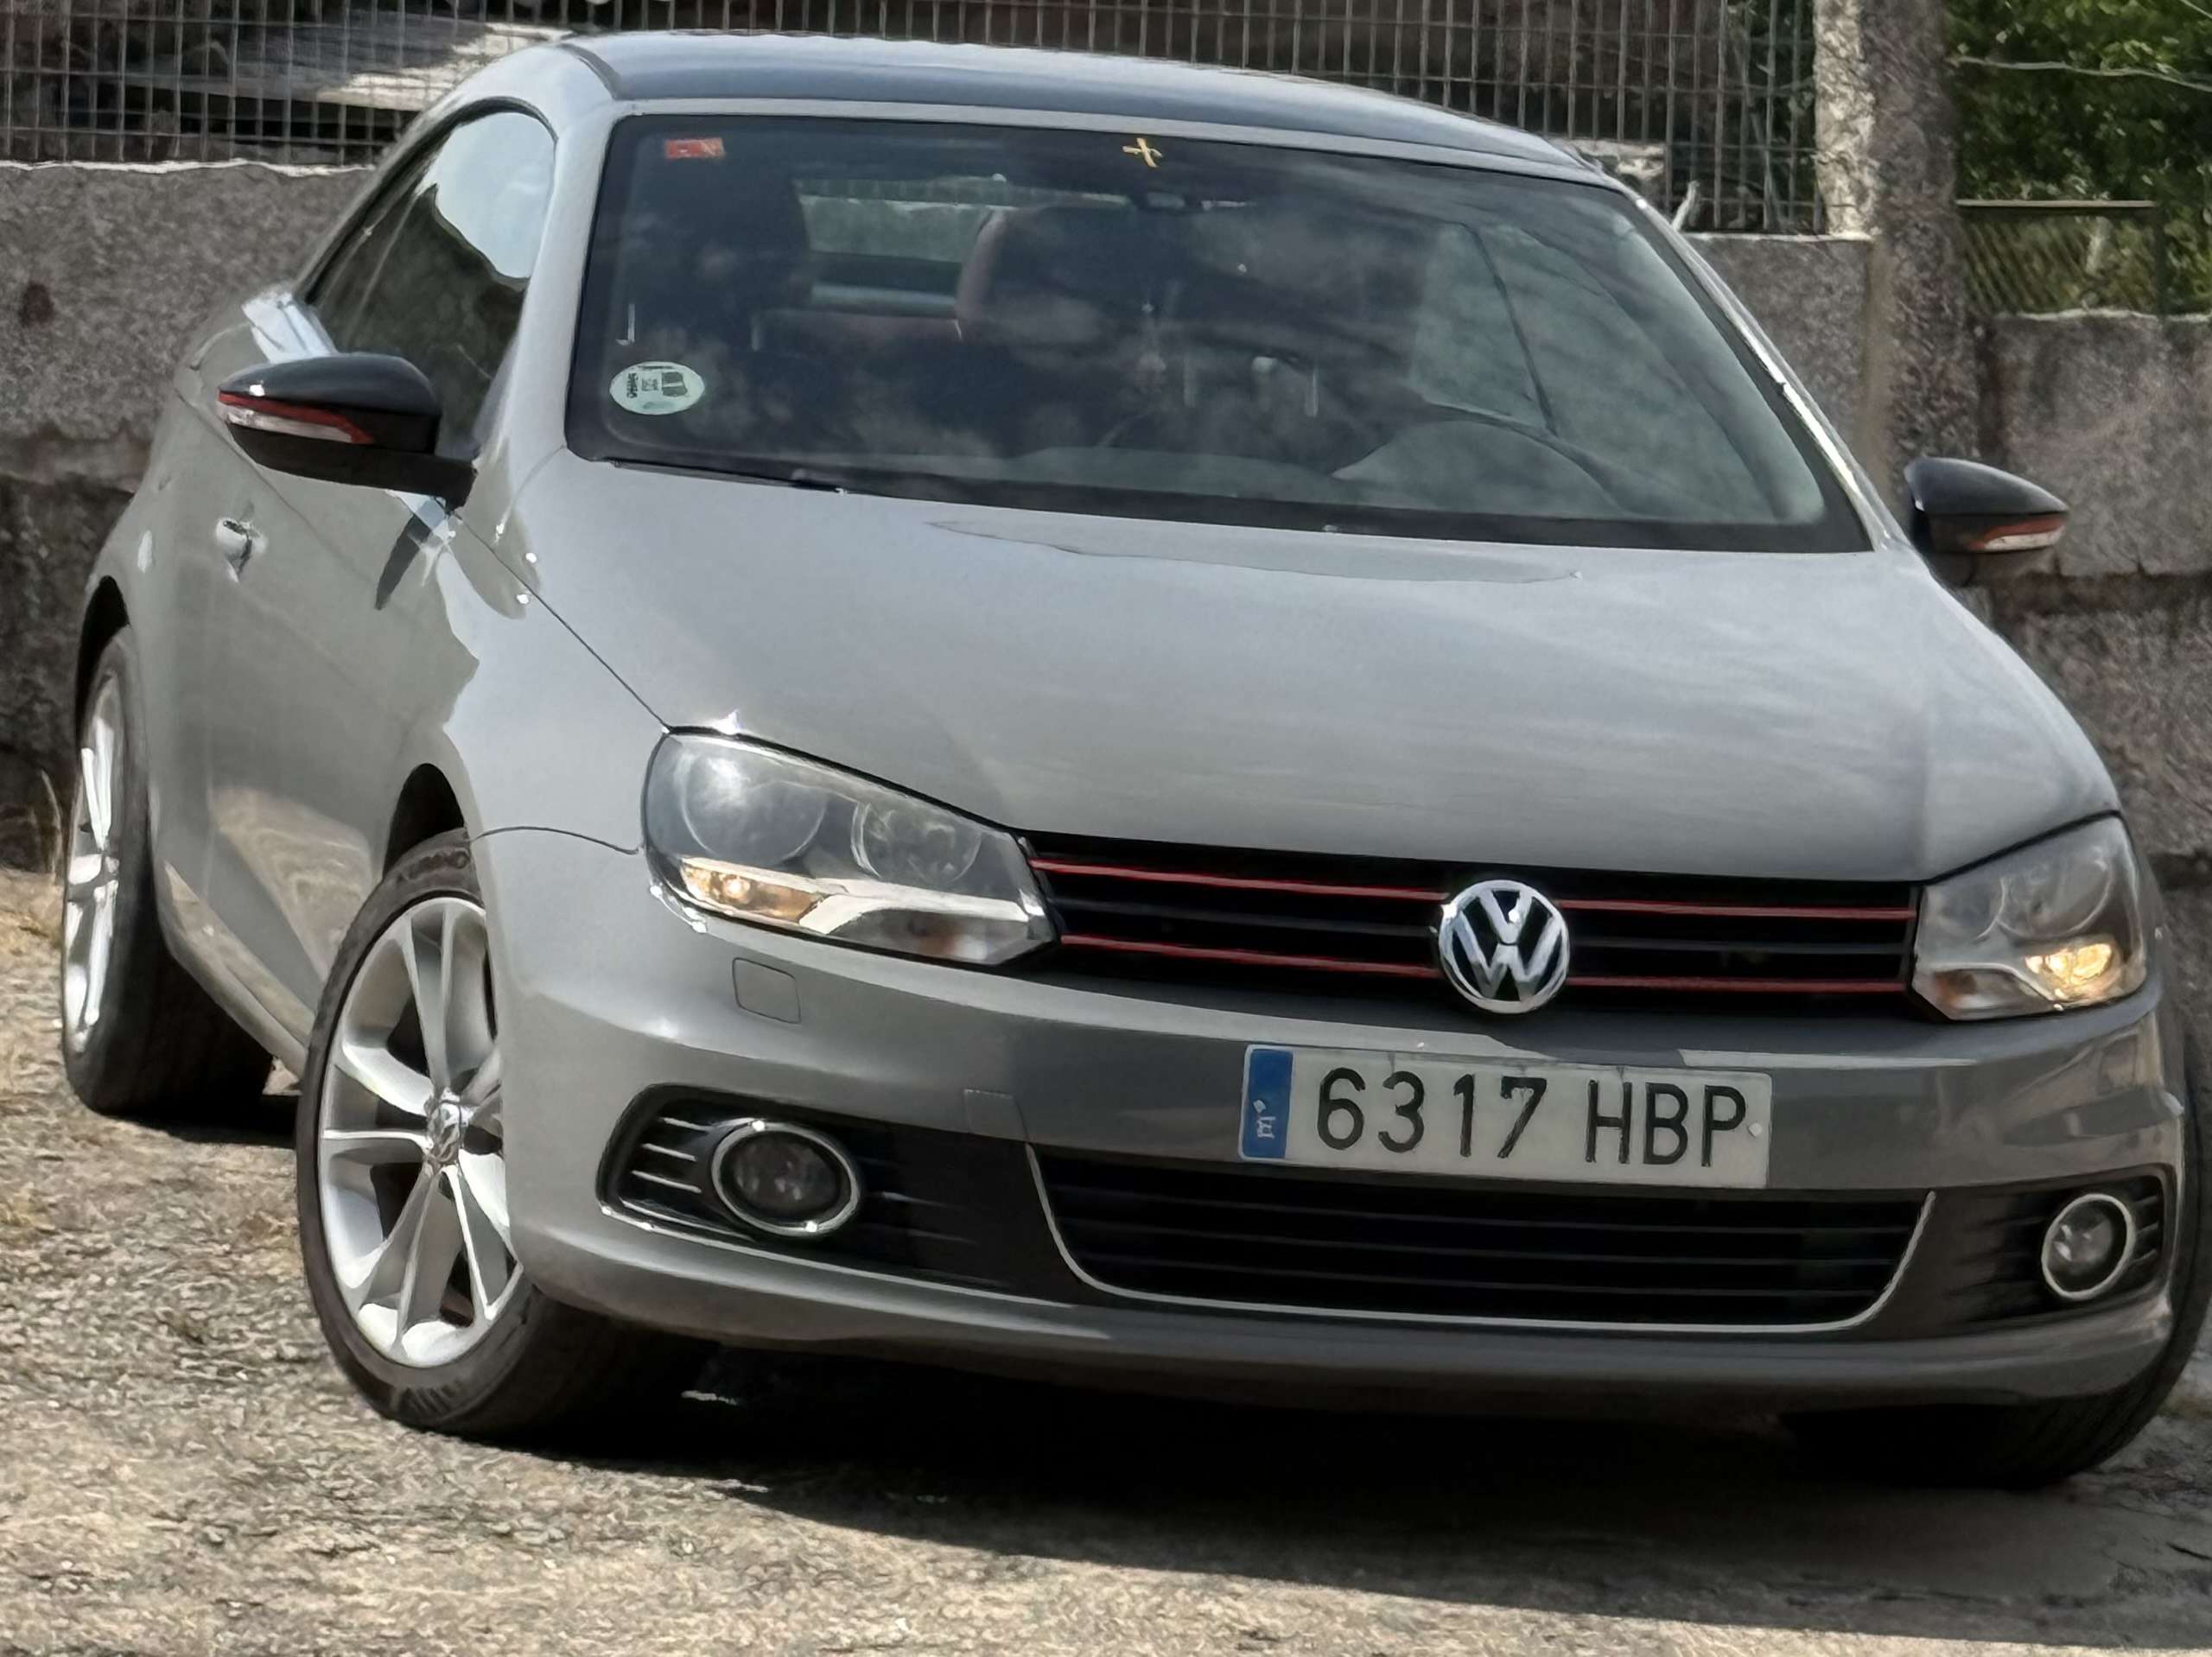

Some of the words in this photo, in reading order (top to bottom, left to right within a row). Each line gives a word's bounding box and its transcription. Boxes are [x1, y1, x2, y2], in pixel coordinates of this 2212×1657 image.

[1447, 887, 1565, 1004] VW
[1316, 1067, 1548, 1159] 6317
[1585, 1078, 1747, 1168] HBP
